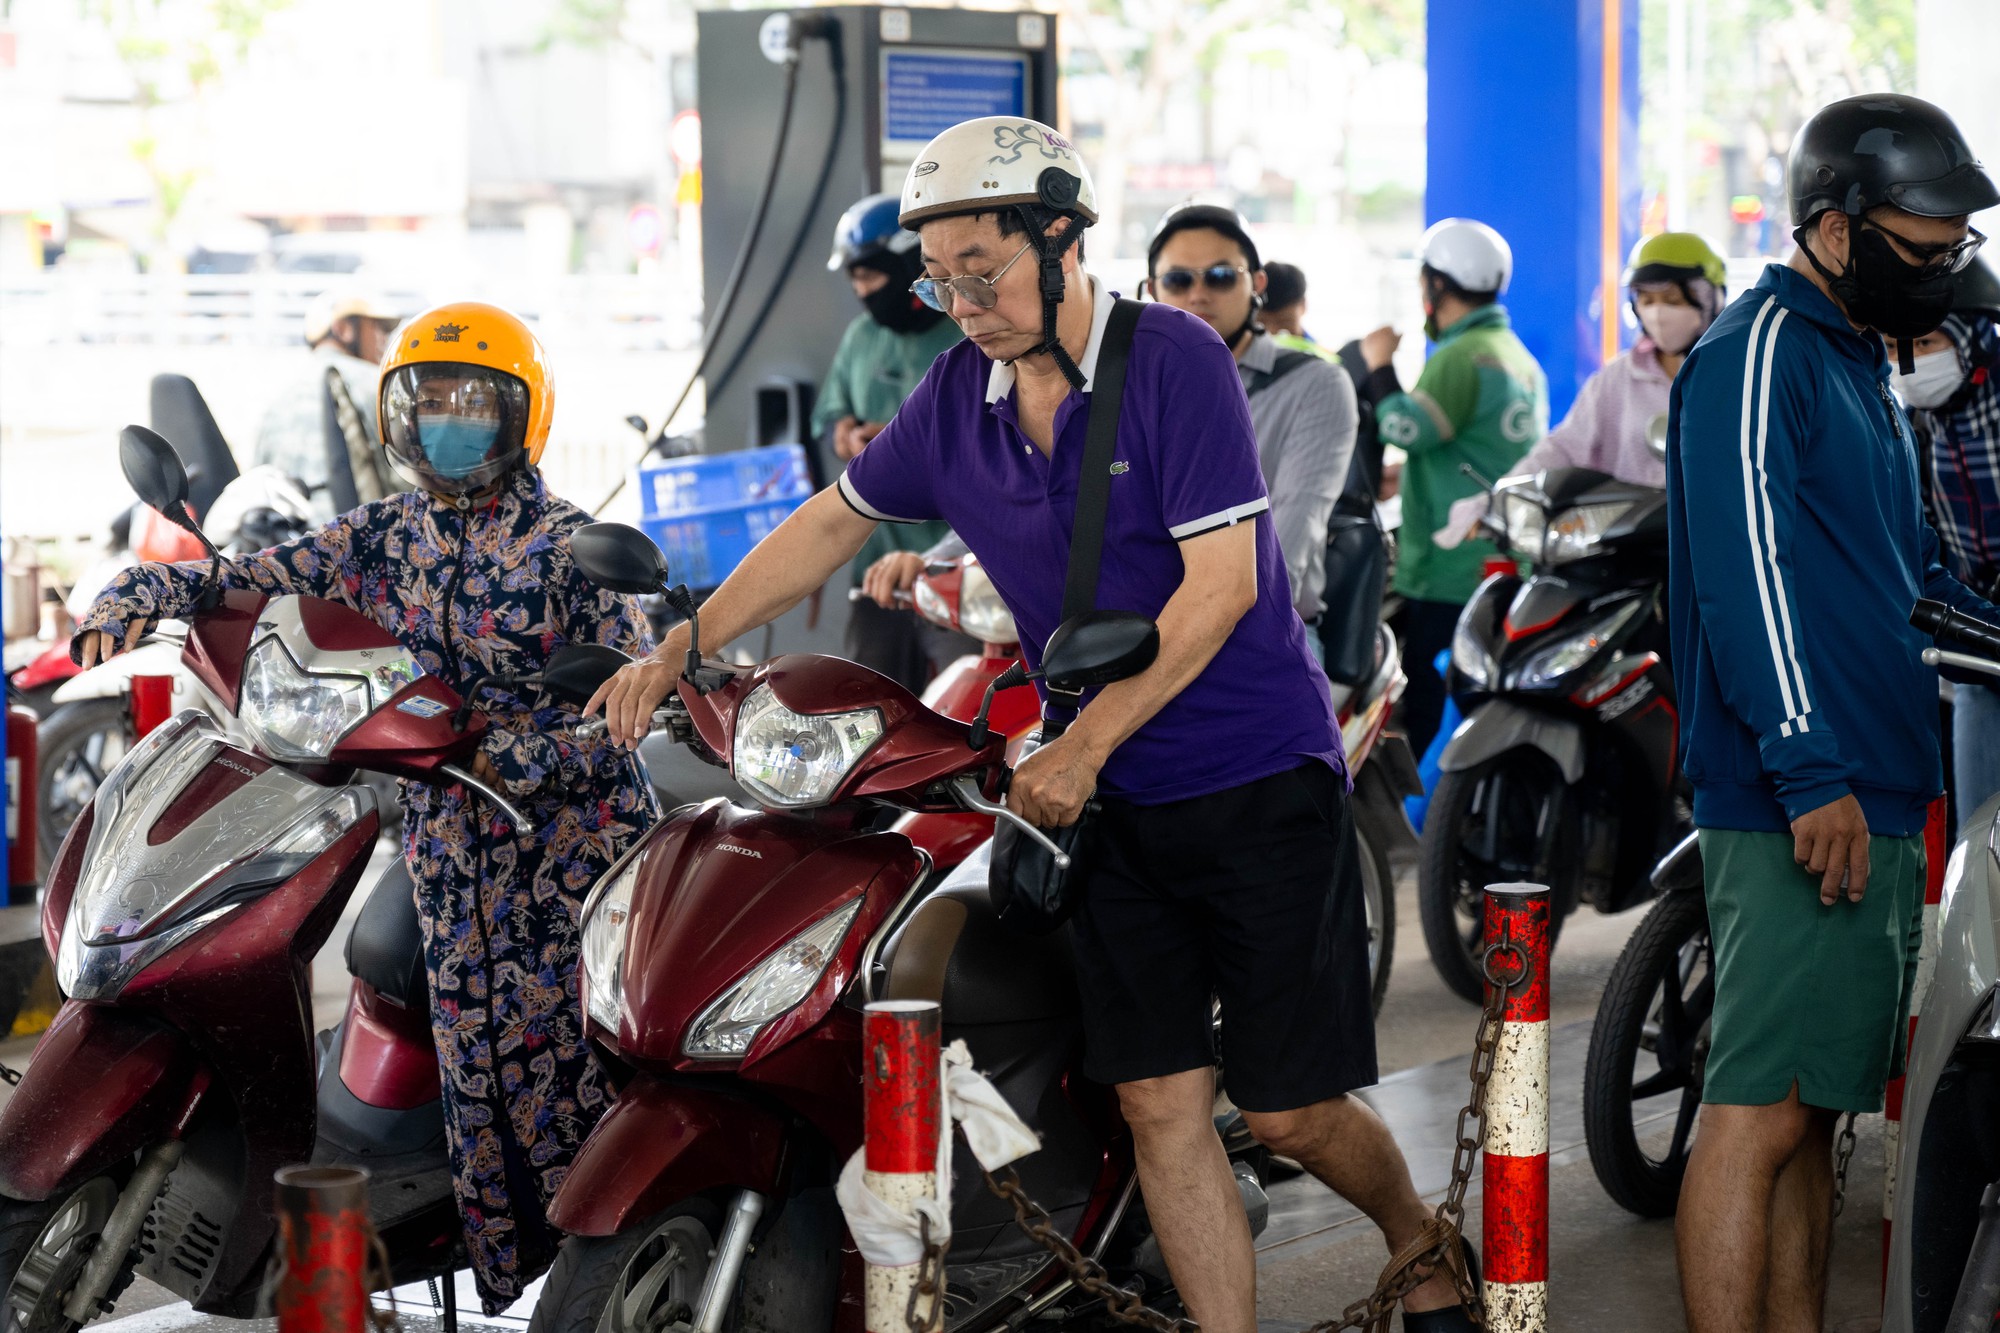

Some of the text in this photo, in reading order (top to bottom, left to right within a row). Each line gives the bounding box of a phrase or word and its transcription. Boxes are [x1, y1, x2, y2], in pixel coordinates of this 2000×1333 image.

[433, 334, 460, 343] Royal
[213, 757, 257, 778] HONDA
[715, 843, 763, 859] HONDA
